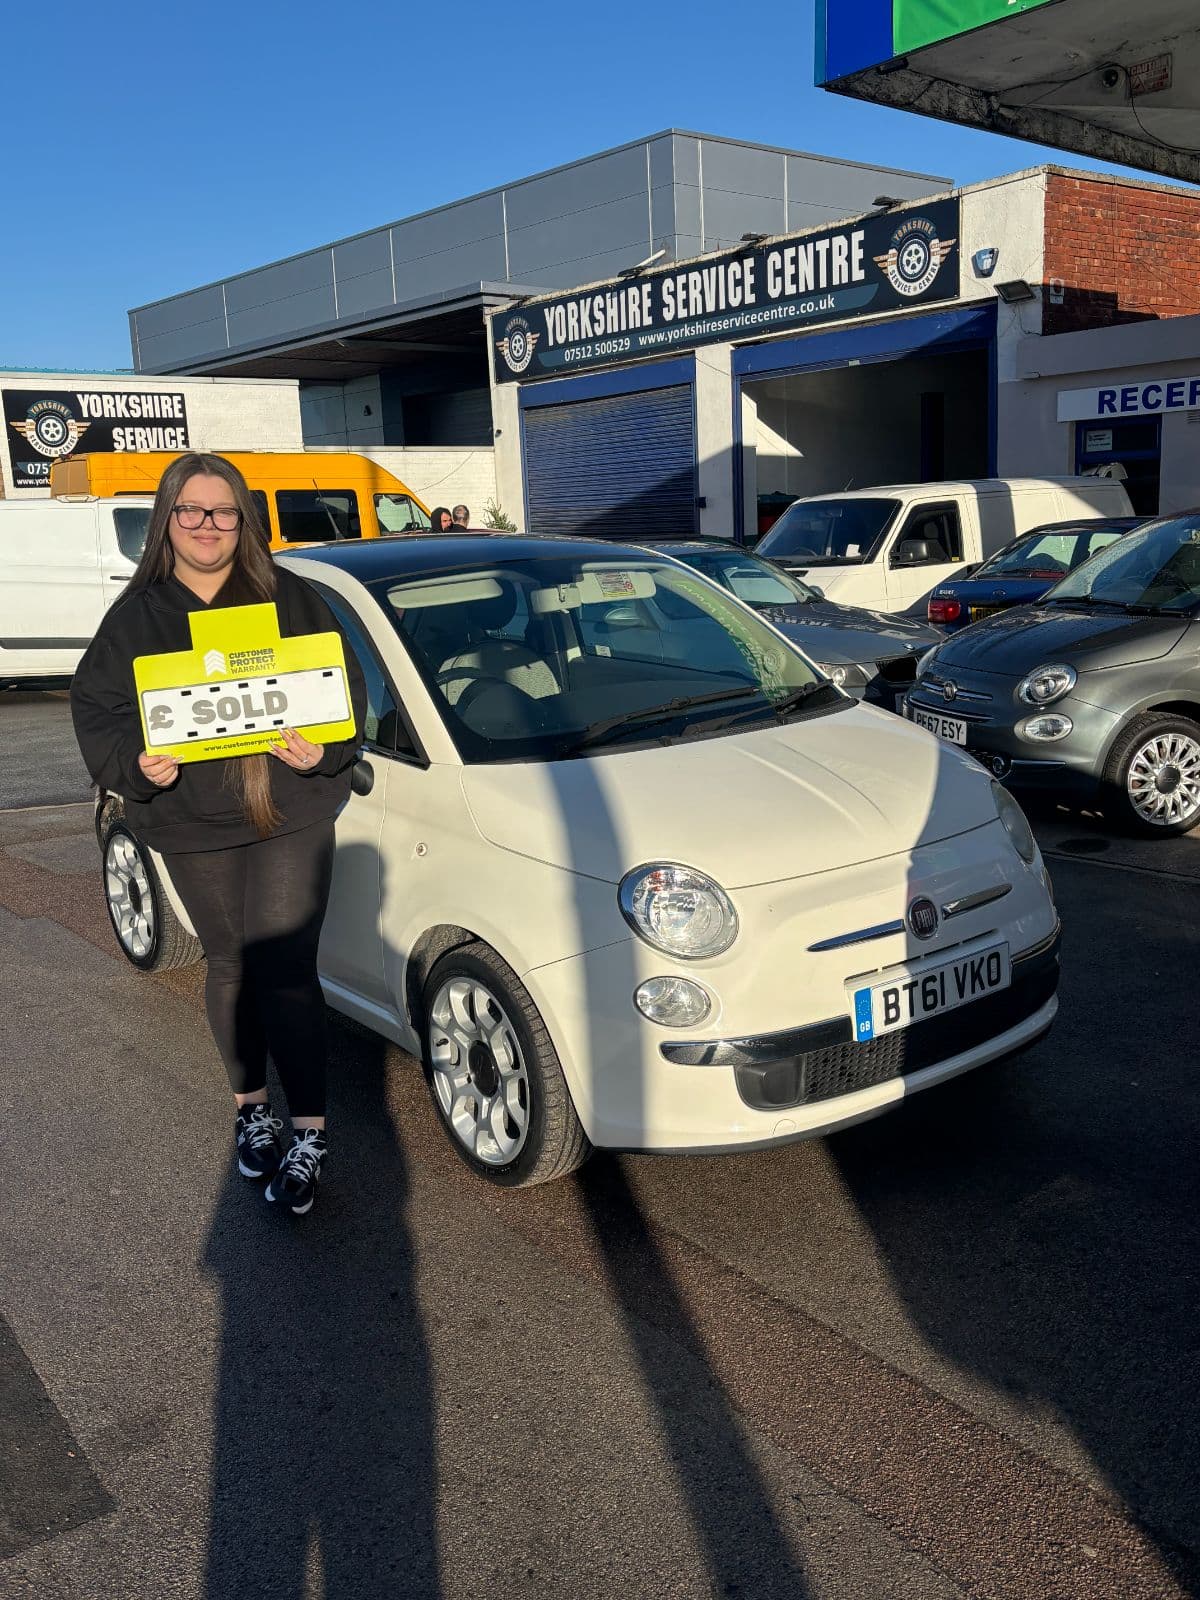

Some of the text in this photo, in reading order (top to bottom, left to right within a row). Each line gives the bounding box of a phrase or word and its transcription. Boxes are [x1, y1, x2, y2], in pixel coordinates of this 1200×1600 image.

[544, 230, 865, 346] YORKSHIRE SERVICE CENTRE
[564, 294, 835, 362] 07512 500529 www.yorkshireservicecentre.co.uk
[76, 394, 183, 418] YORKSHIRE
[112, 426, 187, 449] SERVICE
[27, 463, 51, 475] 075
[228, 648, 274, 660] CUSTOMER
[230, 655, 275, 668] PROTECT
[230, 663, 277, 675] WARRANTY
[191, 690, 288, 725] SOLD
[941, 719, 962, 741] ESY
[882, 951, 1001, 1026] BT61 VKO
[860, 1021, 871, 1033] GB
